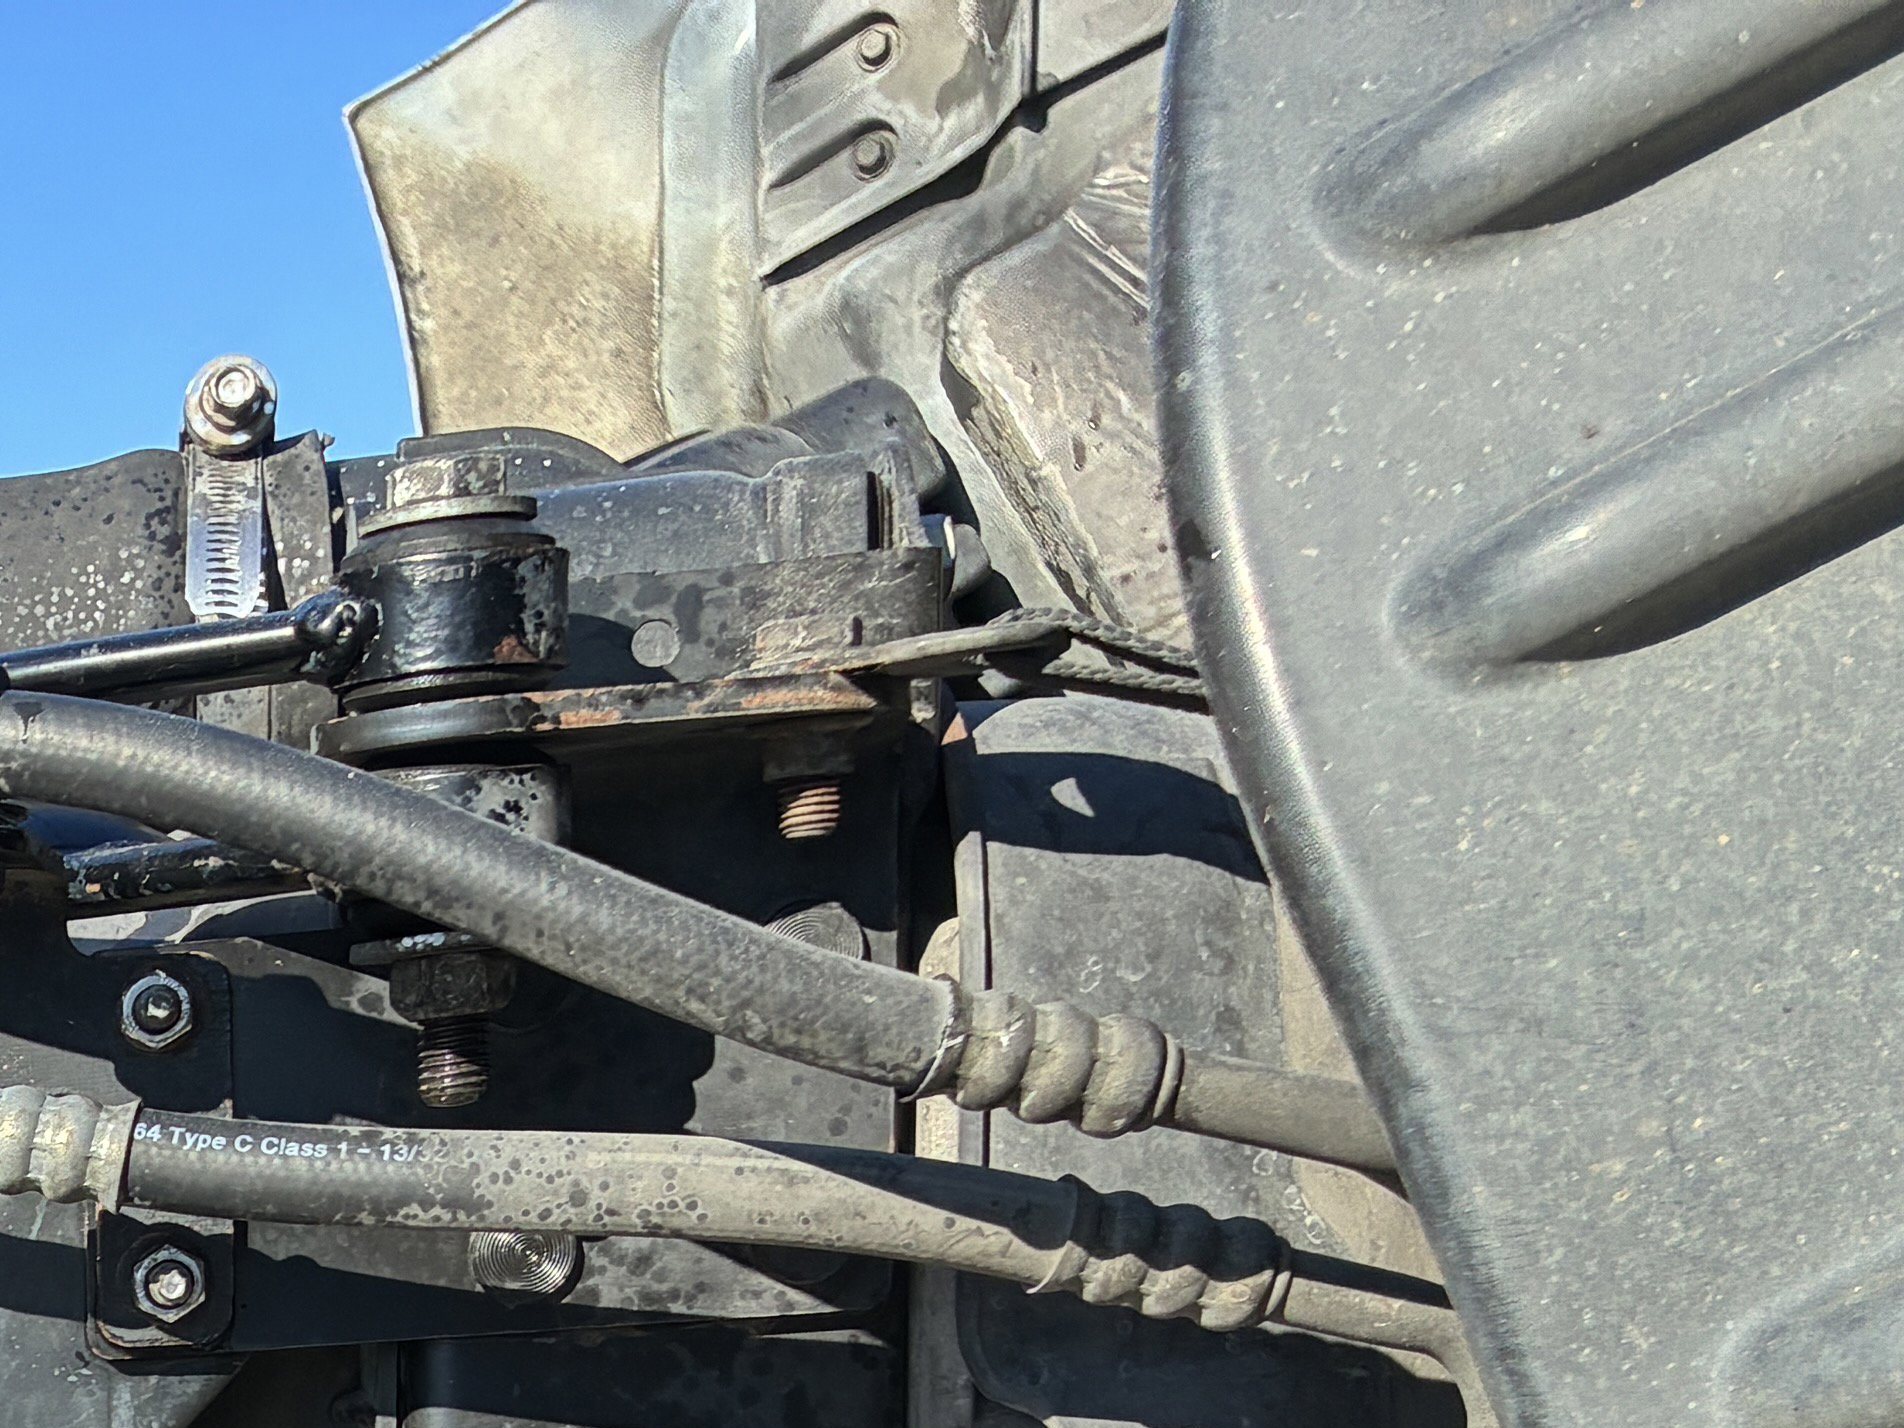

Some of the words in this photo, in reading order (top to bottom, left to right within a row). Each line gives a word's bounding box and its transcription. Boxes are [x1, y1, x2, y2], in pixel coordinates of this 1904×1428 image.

[167, 1125, 227, 1152] Type
[233, 1133, 254, 1154] C
[260, 1135, 328, 1159] Class
[336, 1140, 348, 1160] 1
